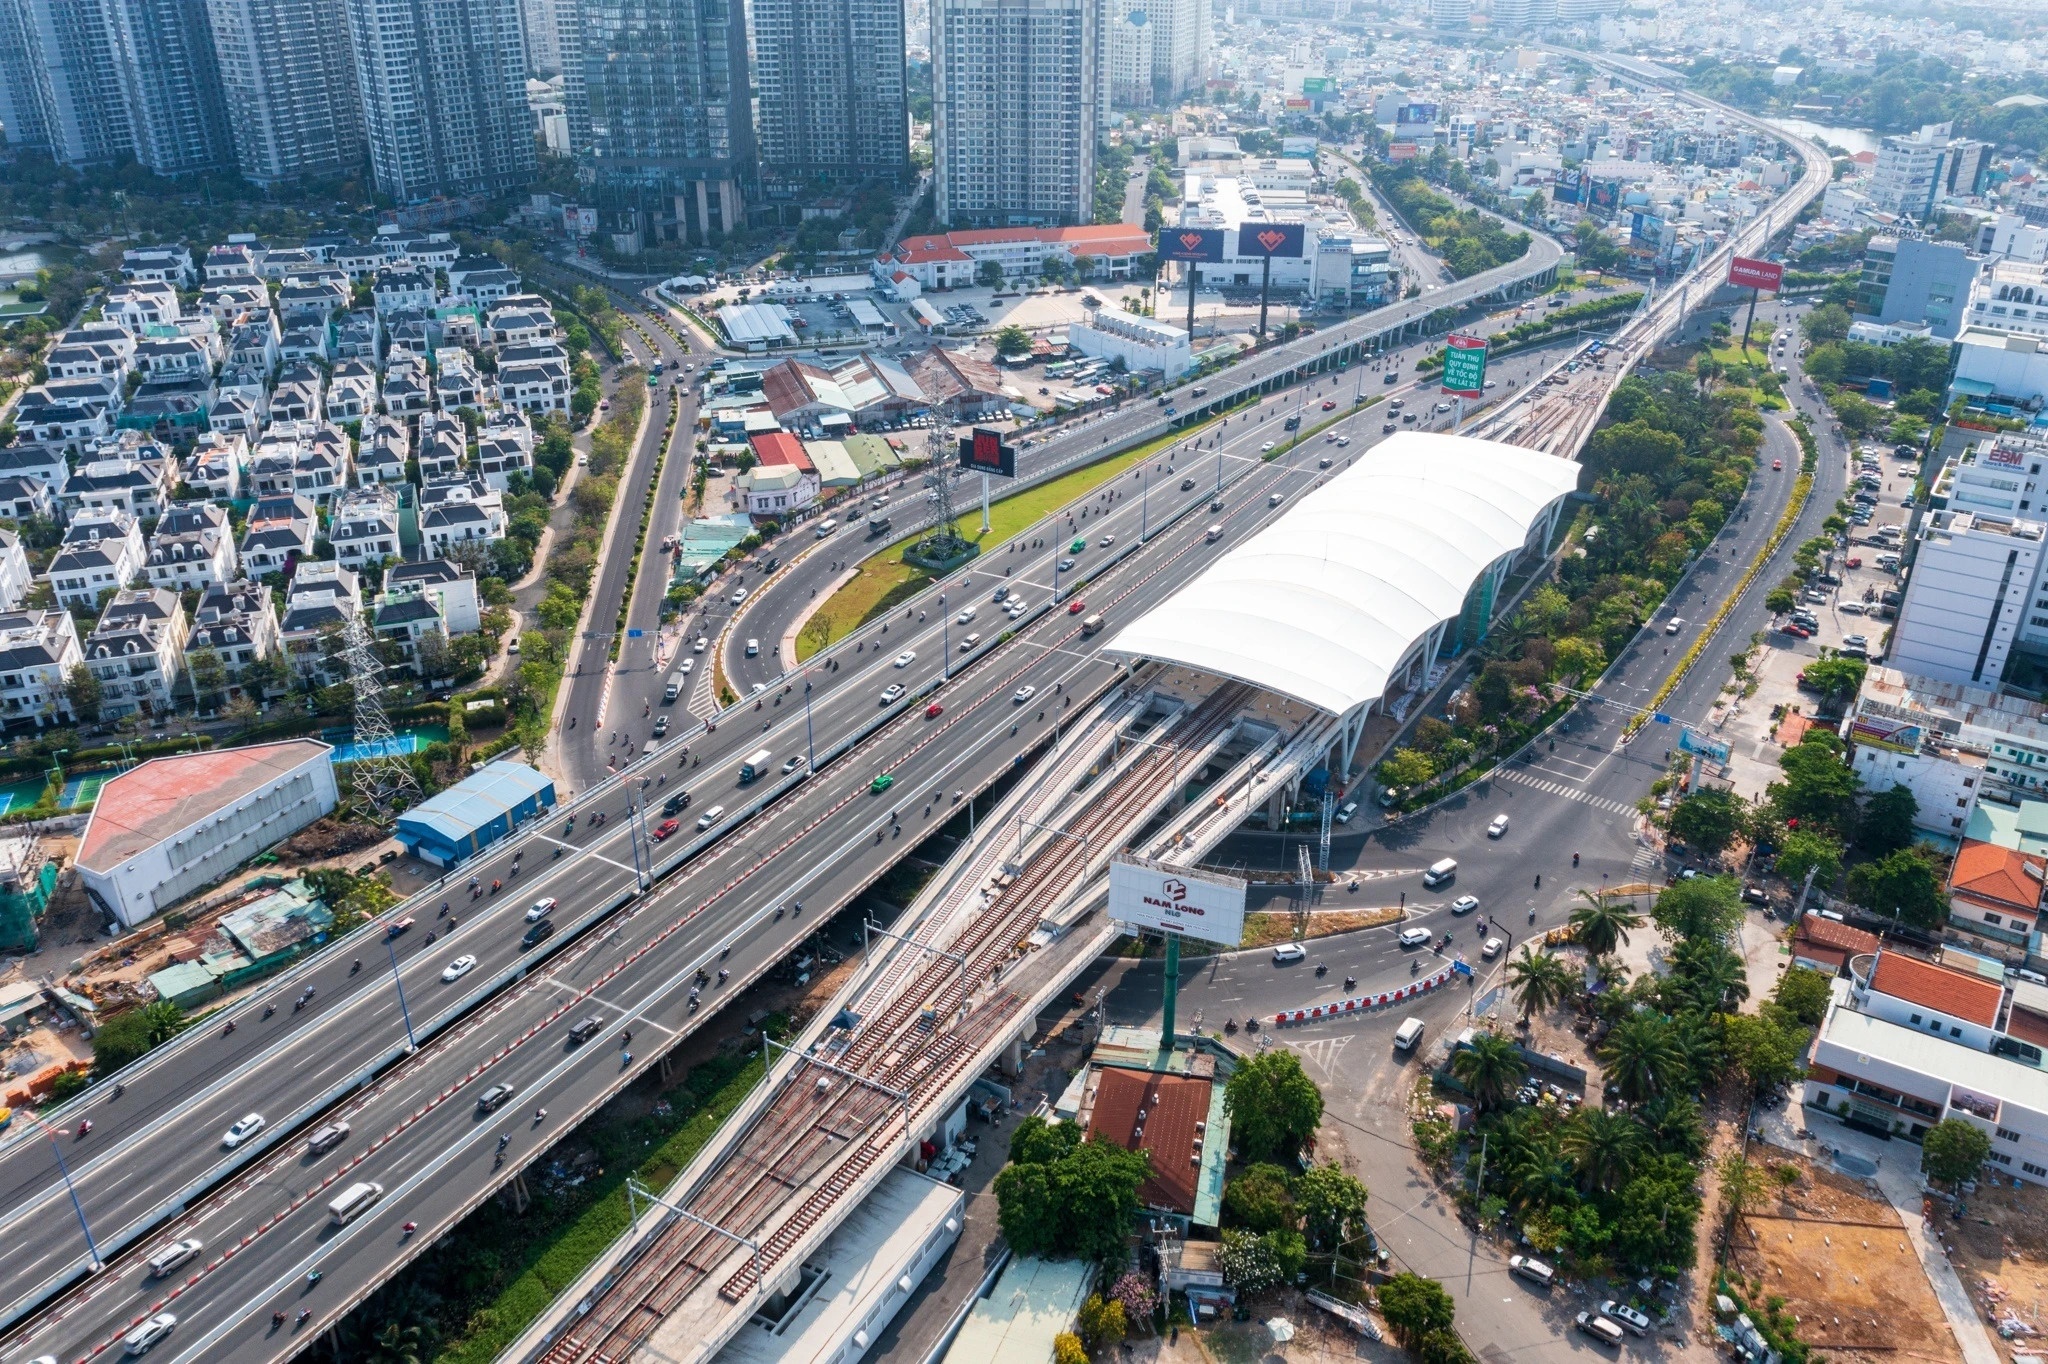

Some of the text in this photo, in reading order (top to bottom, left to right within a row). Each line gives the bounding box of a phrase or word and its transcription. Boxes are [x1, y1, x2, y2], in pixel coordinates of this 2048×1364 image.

[1733, 266, 1760, 276] GAMUDA
[1761, 271, 1778, 279] LAND
[1458, 378, 1468, 386] LÁI
[1989, 449, 2024, 465] EBM
[2003, 463, 2025, 471] Windows
[1143, 896, 1205, 916] NAM LONG
